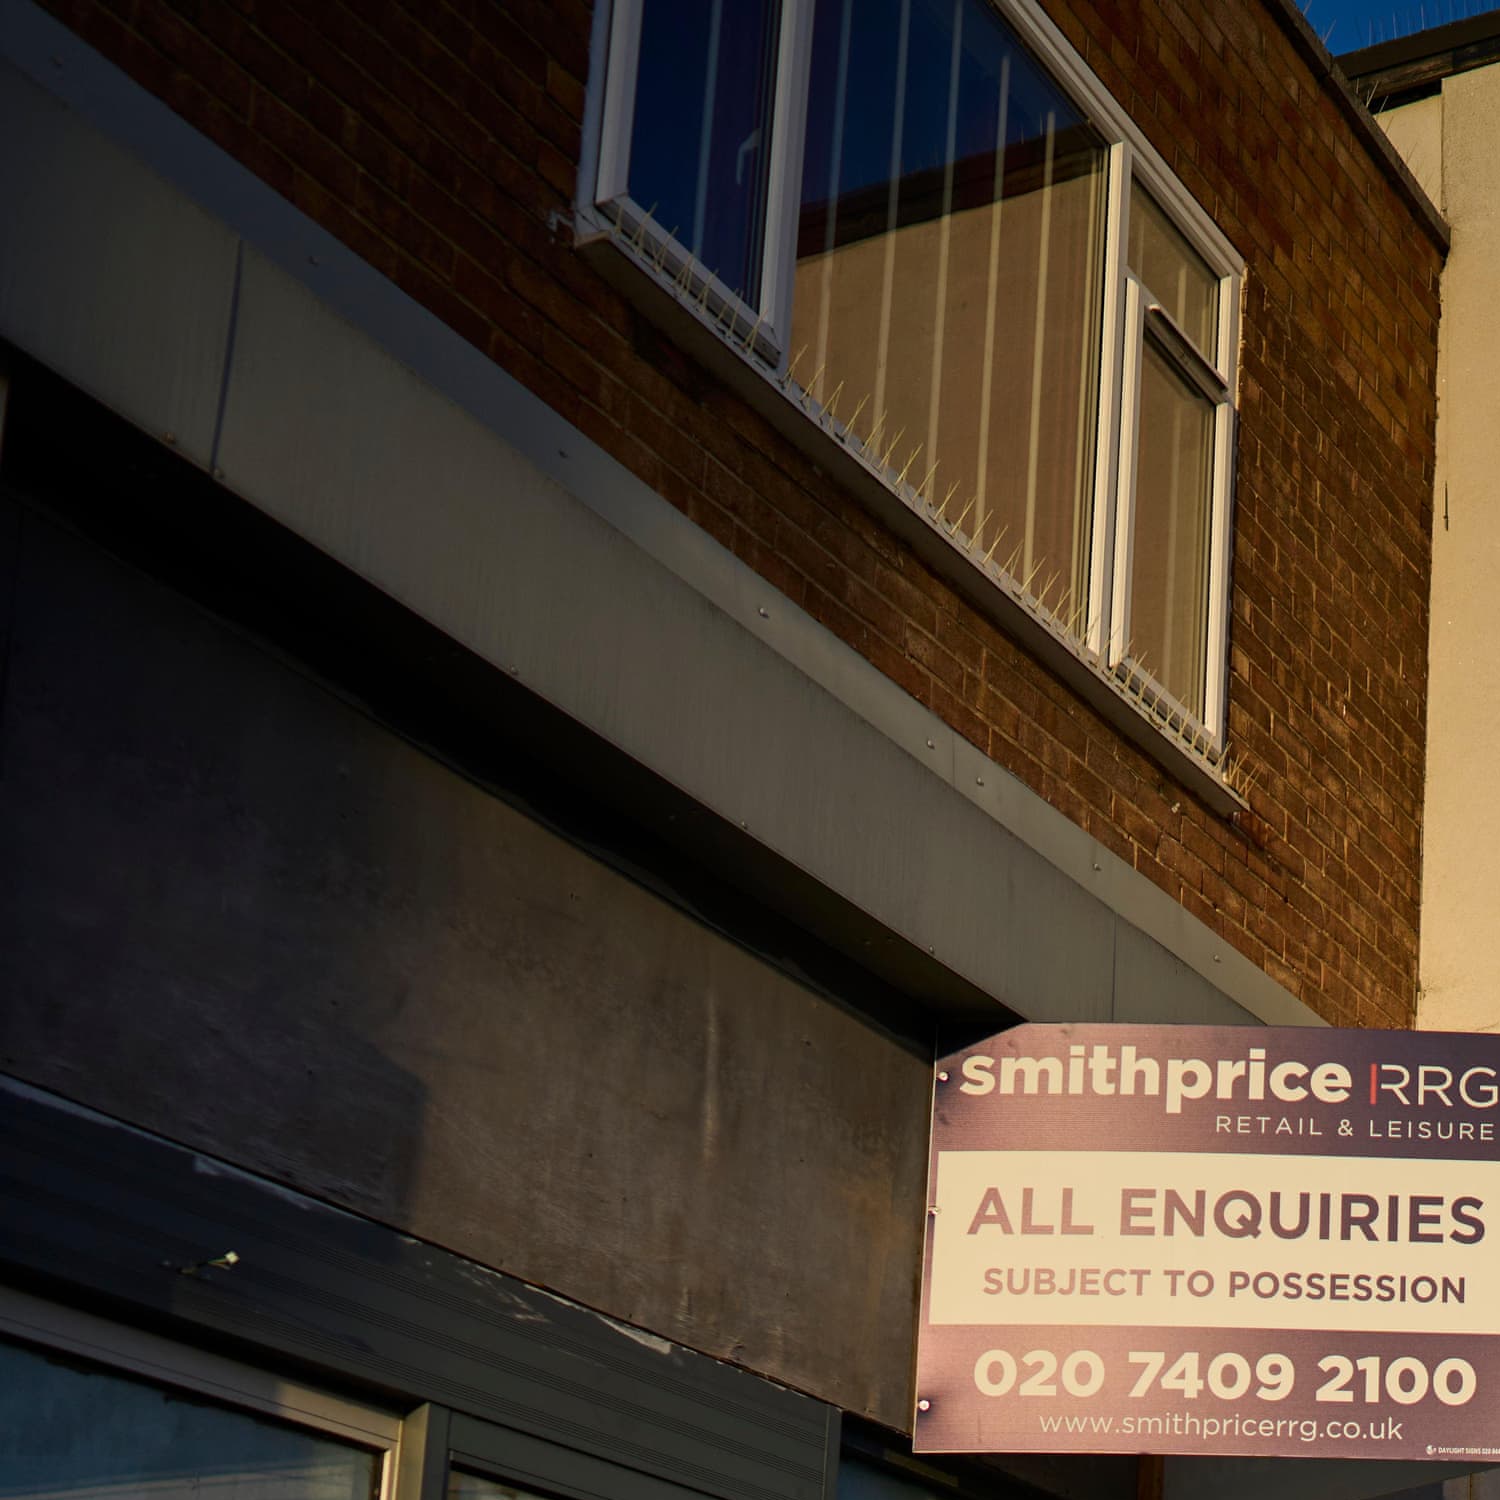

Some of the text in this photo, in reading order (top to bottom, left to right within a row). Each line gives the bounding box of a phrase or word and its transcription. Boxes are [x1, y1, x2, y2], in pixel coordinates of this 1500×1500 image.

[959, 1045, 1499, 1113] smithprice RRG
[1216, 1116, 1495, 1141] RETAIL & LEISURE
[967, 1186, 1486, 1245] ALL ENQUIRIES
[983, 1267, 1466, 1304] SUBJECT TO POSSESSION
[974, 1349, 1477, 1406] 020 7409 2100
[1040, 1411, 1403, 1442] www.smithpricerrg.co.uk
[1438, 1447, 1464, 1455] DAYLIGHT
[1465, 1447, 1480, 1455] SIGNS
